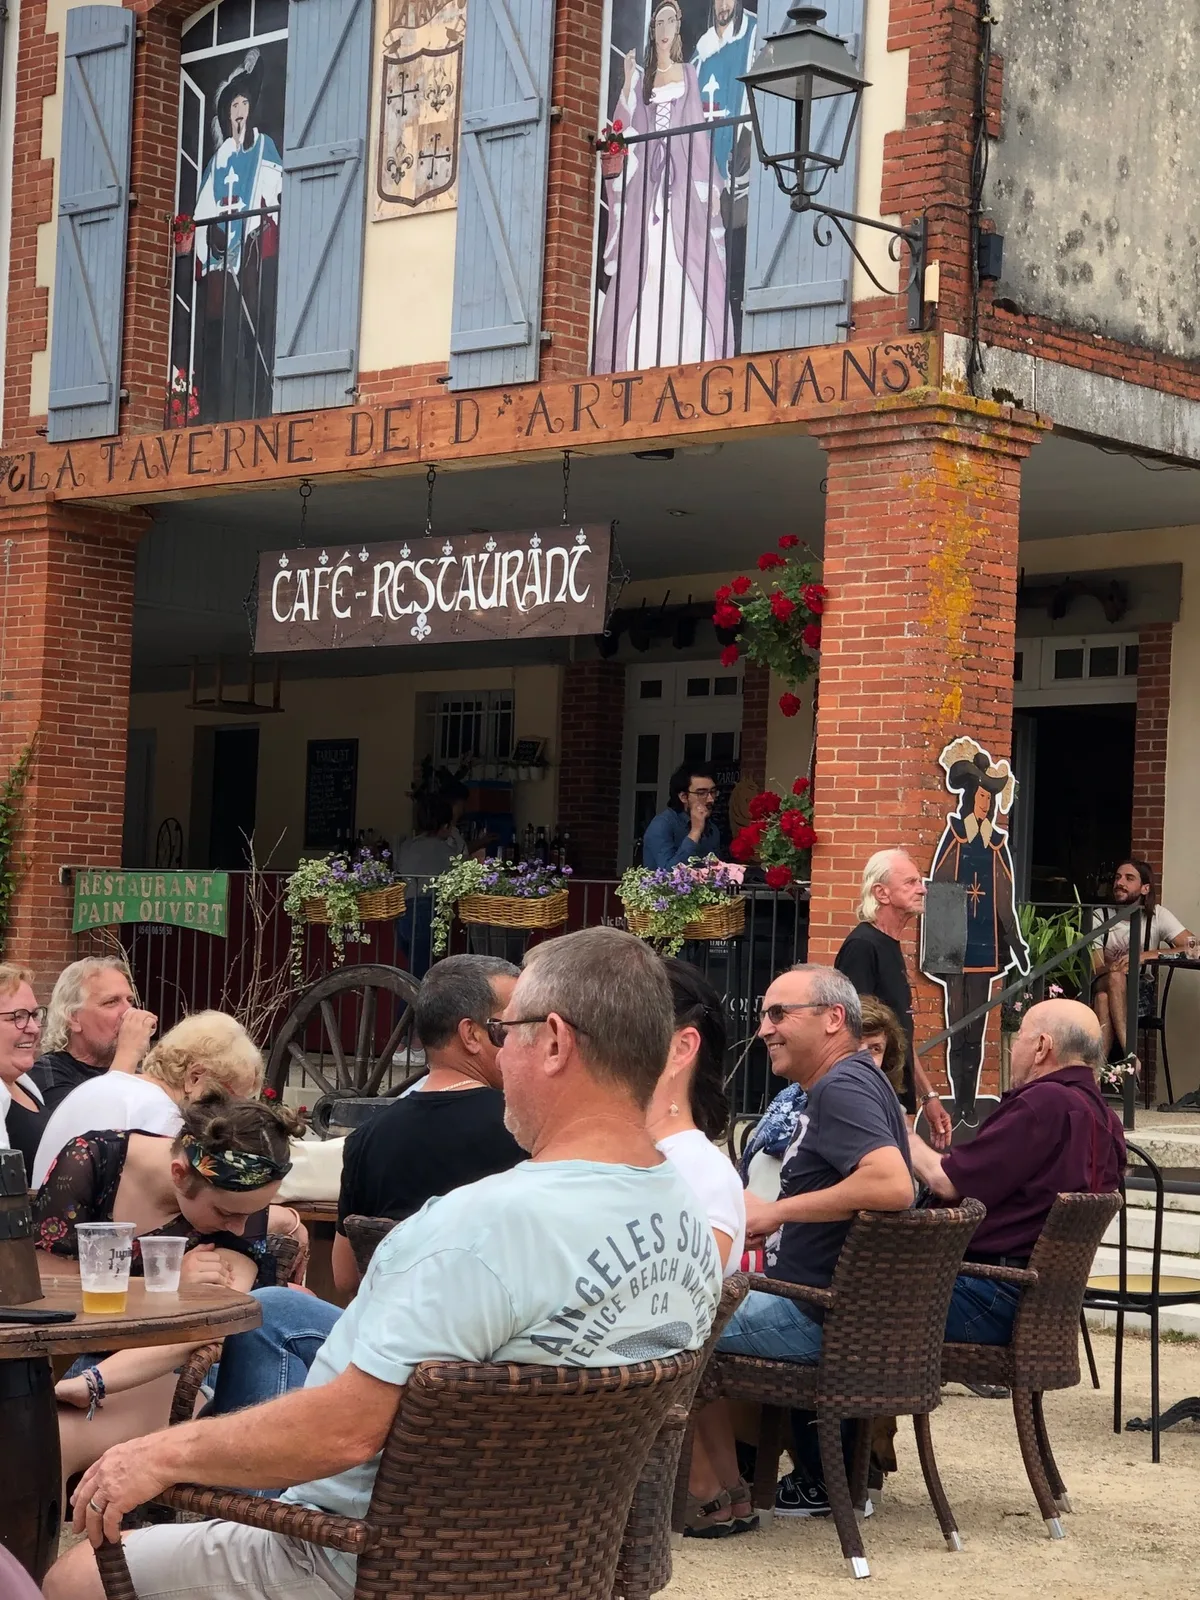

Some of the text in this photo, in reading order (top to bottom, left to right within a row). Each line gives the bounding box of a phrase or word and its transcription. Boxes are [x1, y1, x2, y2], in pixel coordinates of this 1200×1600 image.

[28, 448, 86, 491] LA
[101, 417, 314, 481] TAVERNE
[347, 405, 412, 458] DE
[79, 875, 213, 898] RESTAURANT
[77, 900, 223, 926] PAIN OUVERT
[530, 1212, 666, 1356] ANGELES
[629, 1257, 680, 1299] BEACH
[651, 1291, 669, 1316] CA
